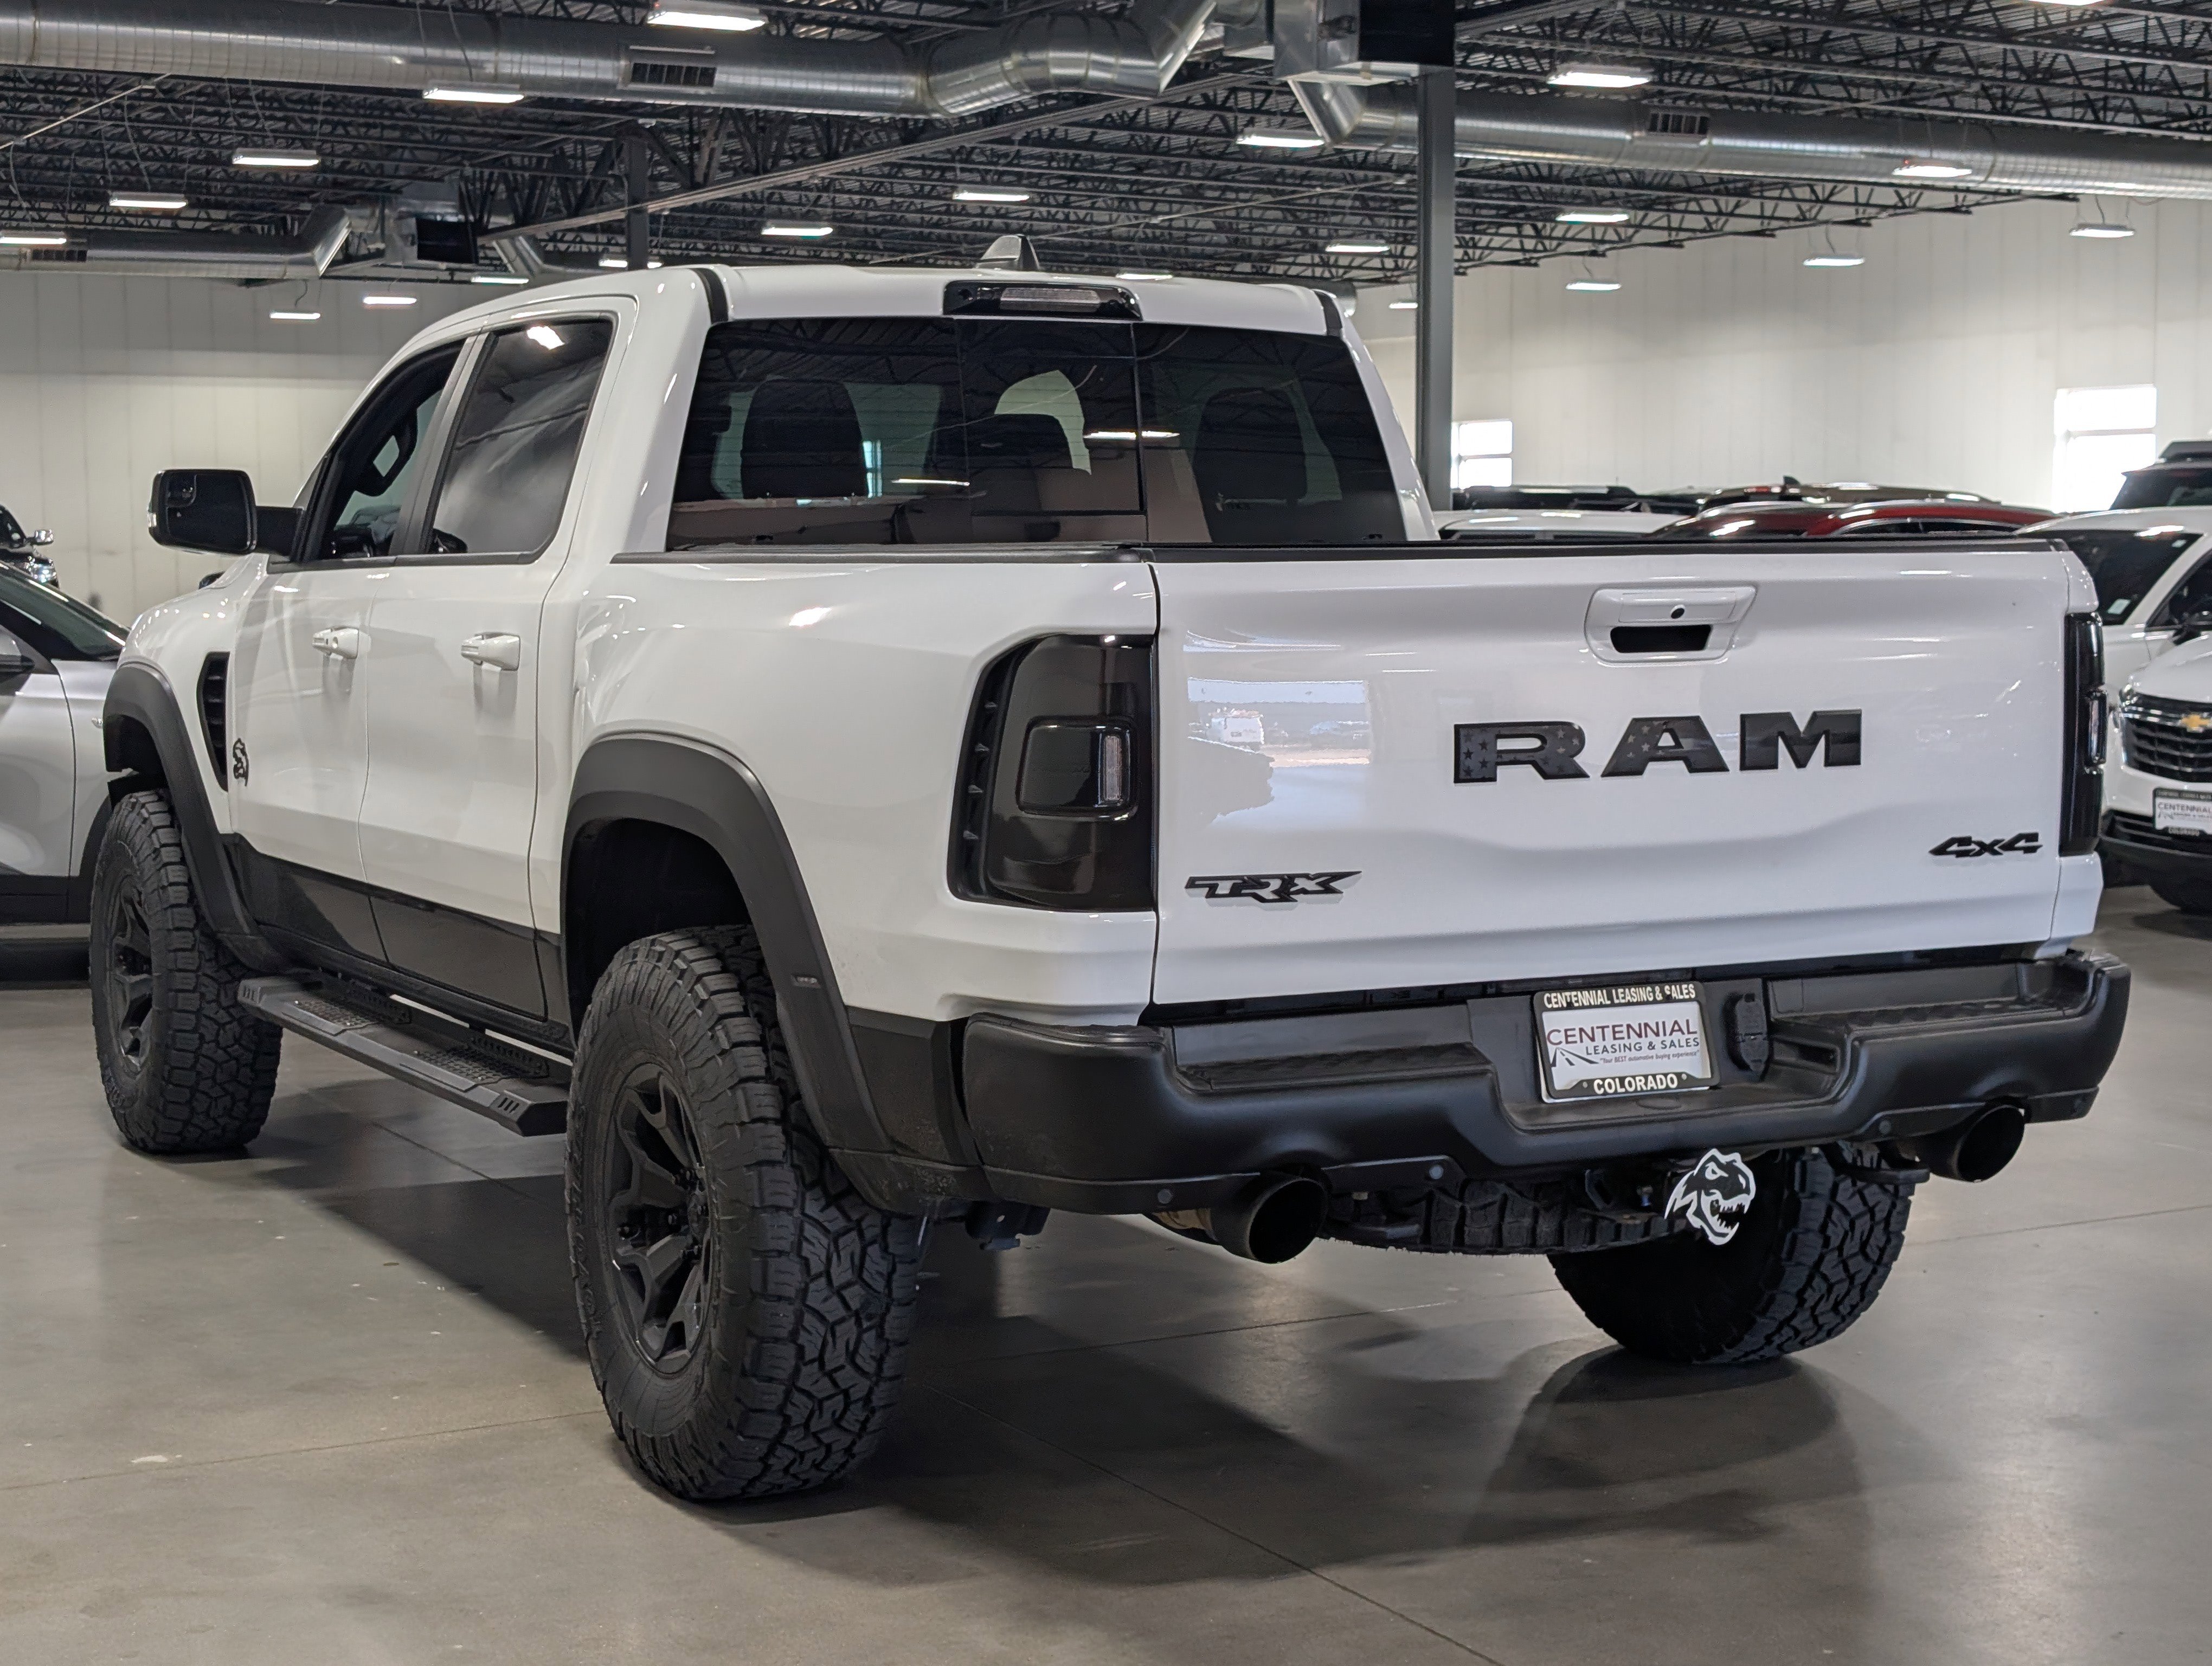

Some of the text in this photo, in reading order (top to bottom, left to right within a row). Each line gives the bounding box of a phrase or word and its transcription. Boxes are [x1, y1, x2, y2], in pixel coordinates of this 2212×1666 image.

[1454, 708, 1862, 784] RAM
[1185, 871, 1362, 903] TRX
[1544, 984, 1696, 1009] CENTENNIAL LEASING & SALES
[1547, 1019, 1697, 1046] CENTENNIAL
[1586, 1037, 1700, 1055] LEASING & SALES
[1593, 1073, 1678, 1095] COLORADO
